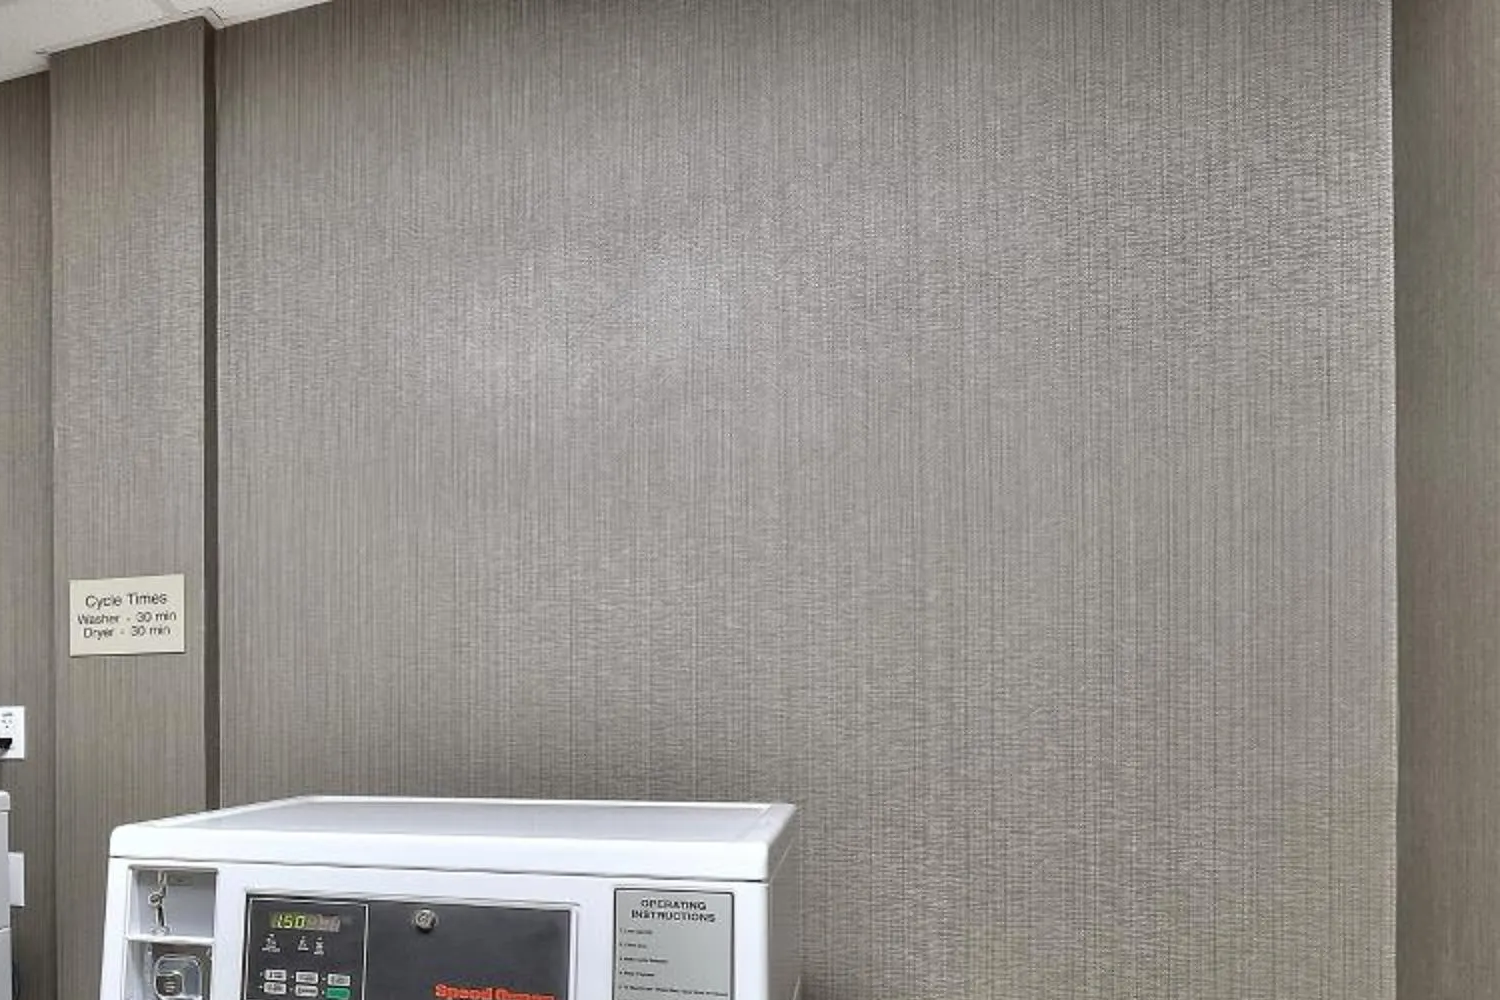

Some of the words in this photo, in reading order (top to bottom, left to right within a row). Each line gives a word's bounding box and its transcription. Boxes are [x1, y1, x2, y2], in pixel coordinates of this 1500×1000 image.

[85, 594, 122, 610] Cycle
[126, 592, 168, 605] Times
[77, 614, 119, 624] Washer
[136, 611, 152, 622] 30
[155, 610, 177, 621] min
[83, 627, 114, 640] Dryer
[131, 625, 146, 636] 30
[149, 625, 171, 636] min
[641, 899, 707, 910] OPERATING
[631, 909, 716, 922] INSTRUCTIONS
[435, 983, 493, 1000] Speed
